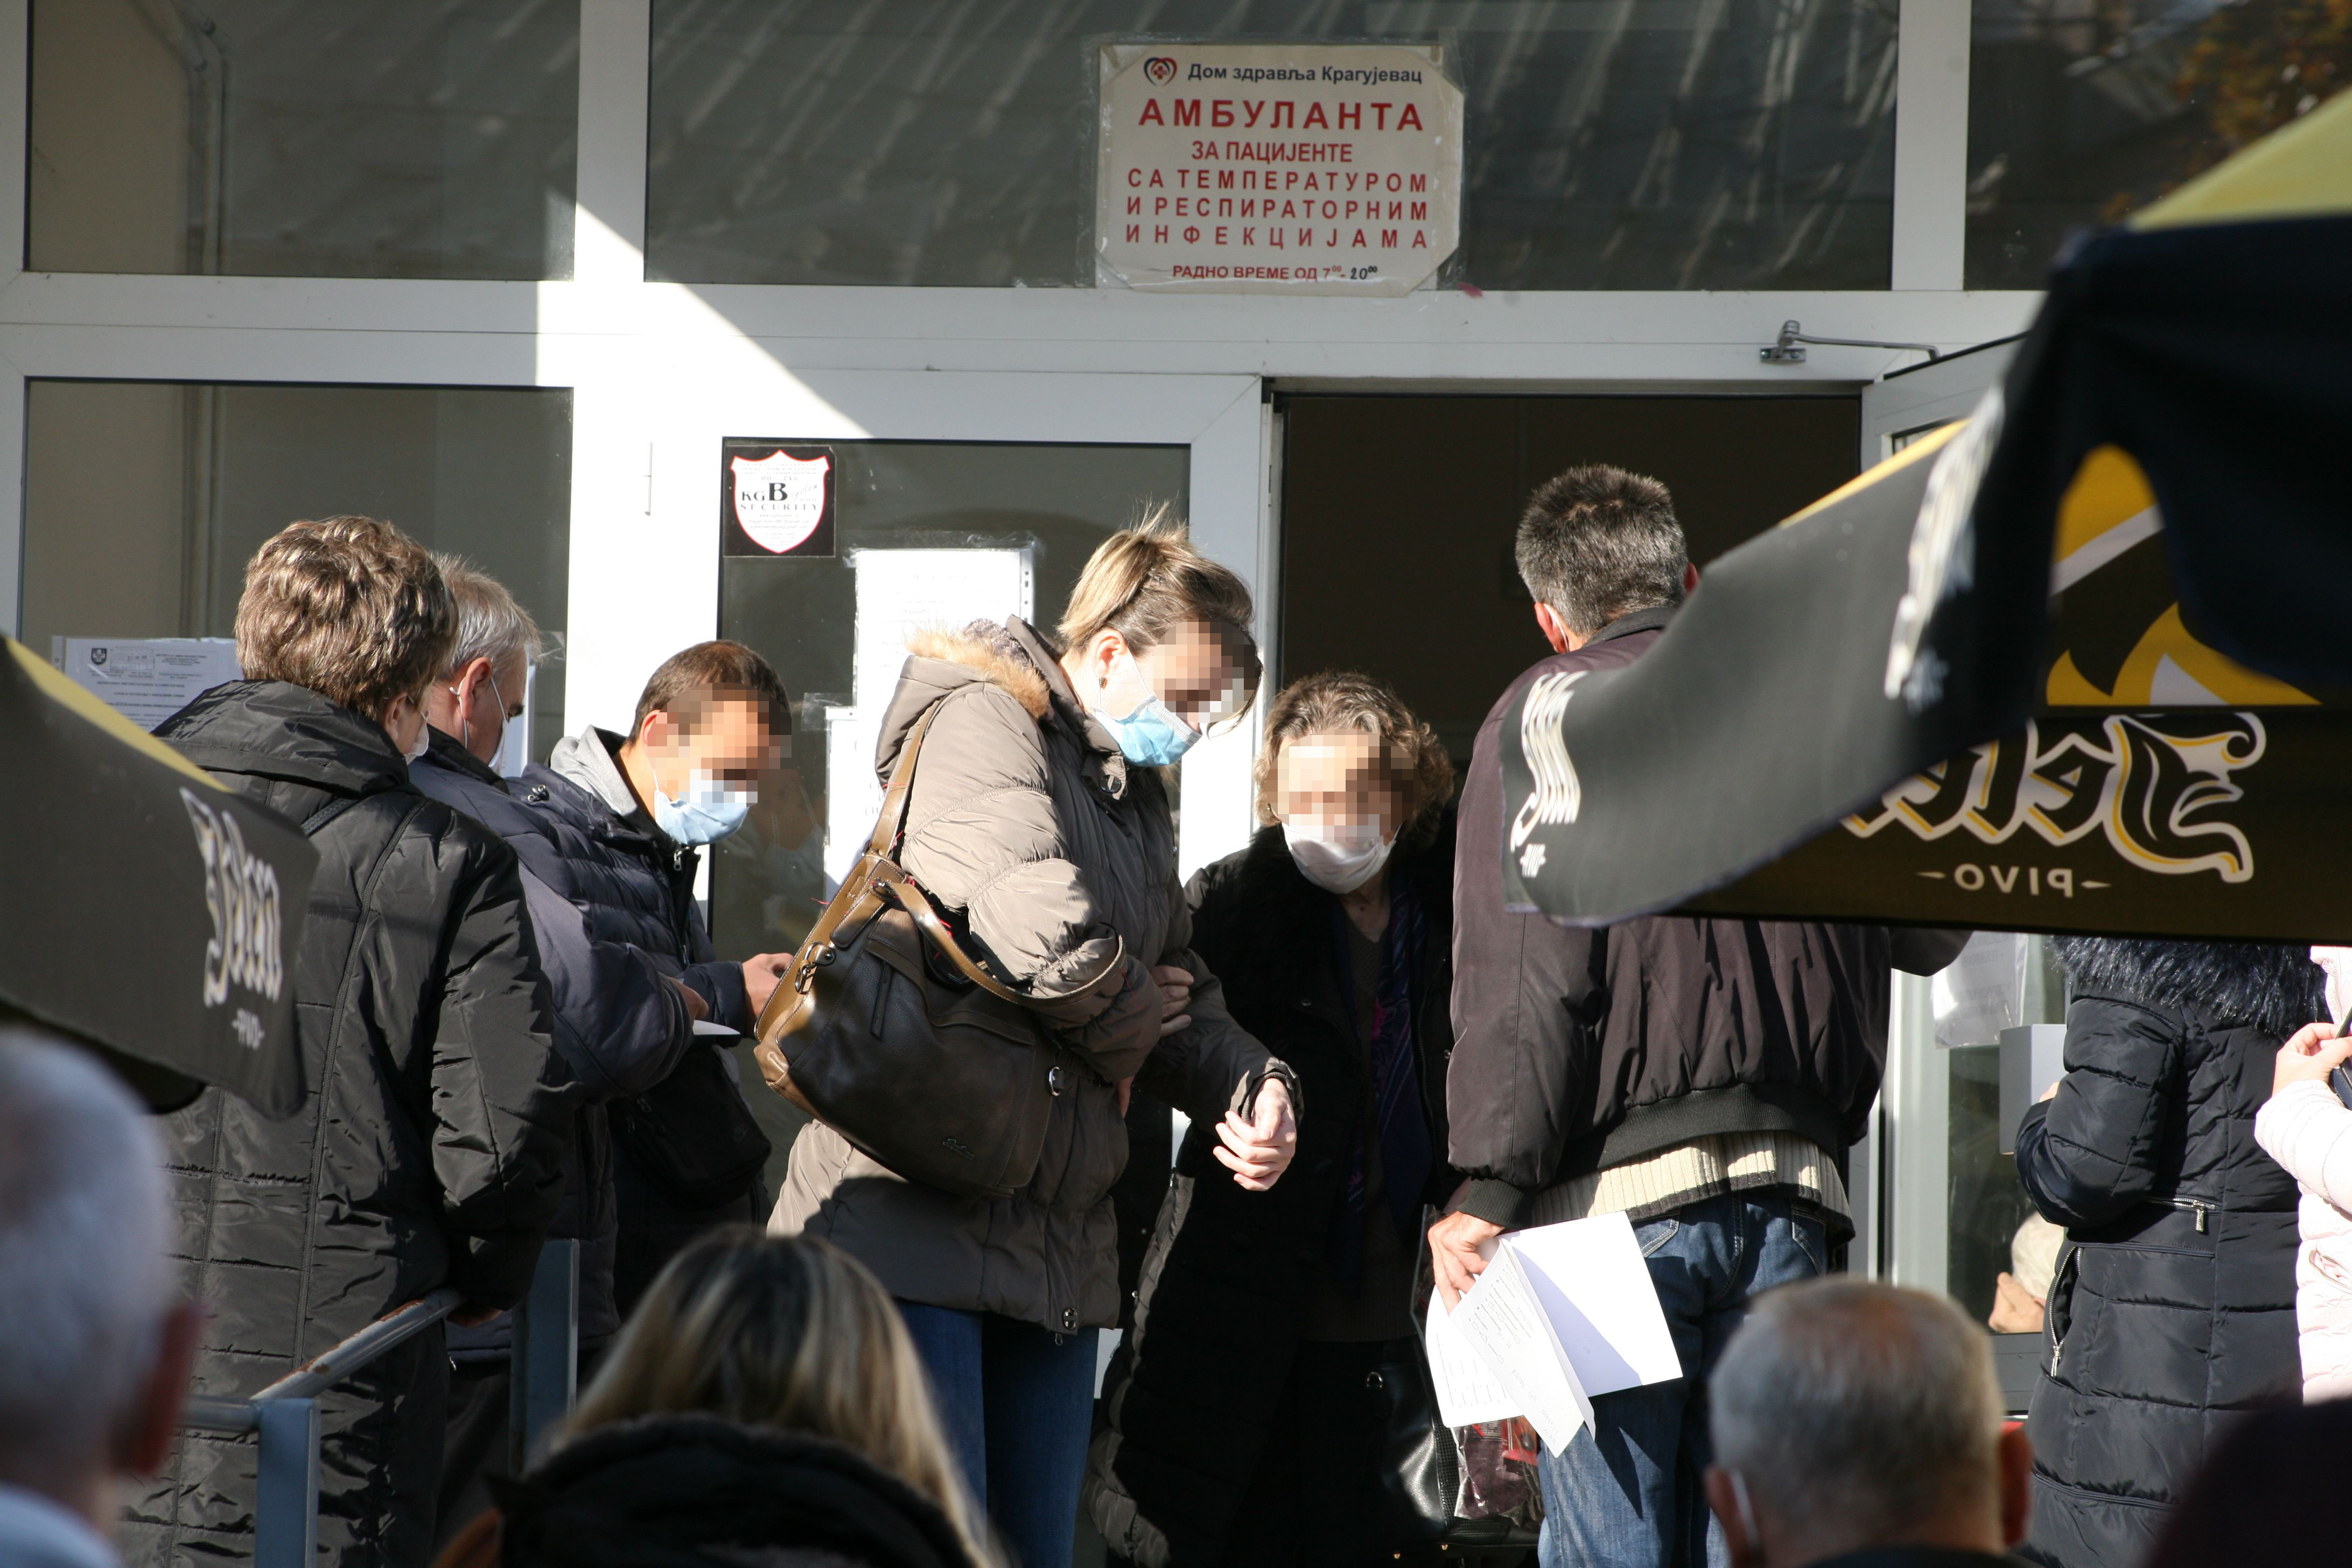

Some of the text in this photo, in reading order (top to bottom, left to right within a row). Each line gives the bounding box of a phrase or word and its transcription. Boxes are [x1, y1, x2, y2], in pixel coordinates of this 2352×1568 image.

[1188, 63, 1423, 86] Дом здравља Крагујевац
[1138, 98, 1423, 131] АМБУЛАНТА
[1191, 140, 1353, 164] ЗА ПАЦИЈЕНТЕ
[1128, 168, 1426, 192] СА ТЕМПЕРАТУРОМ
[1127, 197, 1427, 220] И РЕСПИРАТОРНИМ
[1126, 224, 1427, 248] ИНФЕКЦИЈАМА
[1172, 265, 1229, 279] РАДНО
[1233, 267, 1289, 279] ВРЕМЕ
[1294, 267, 1318, 281] ОД
[742, 482, 788, 501] KGB
